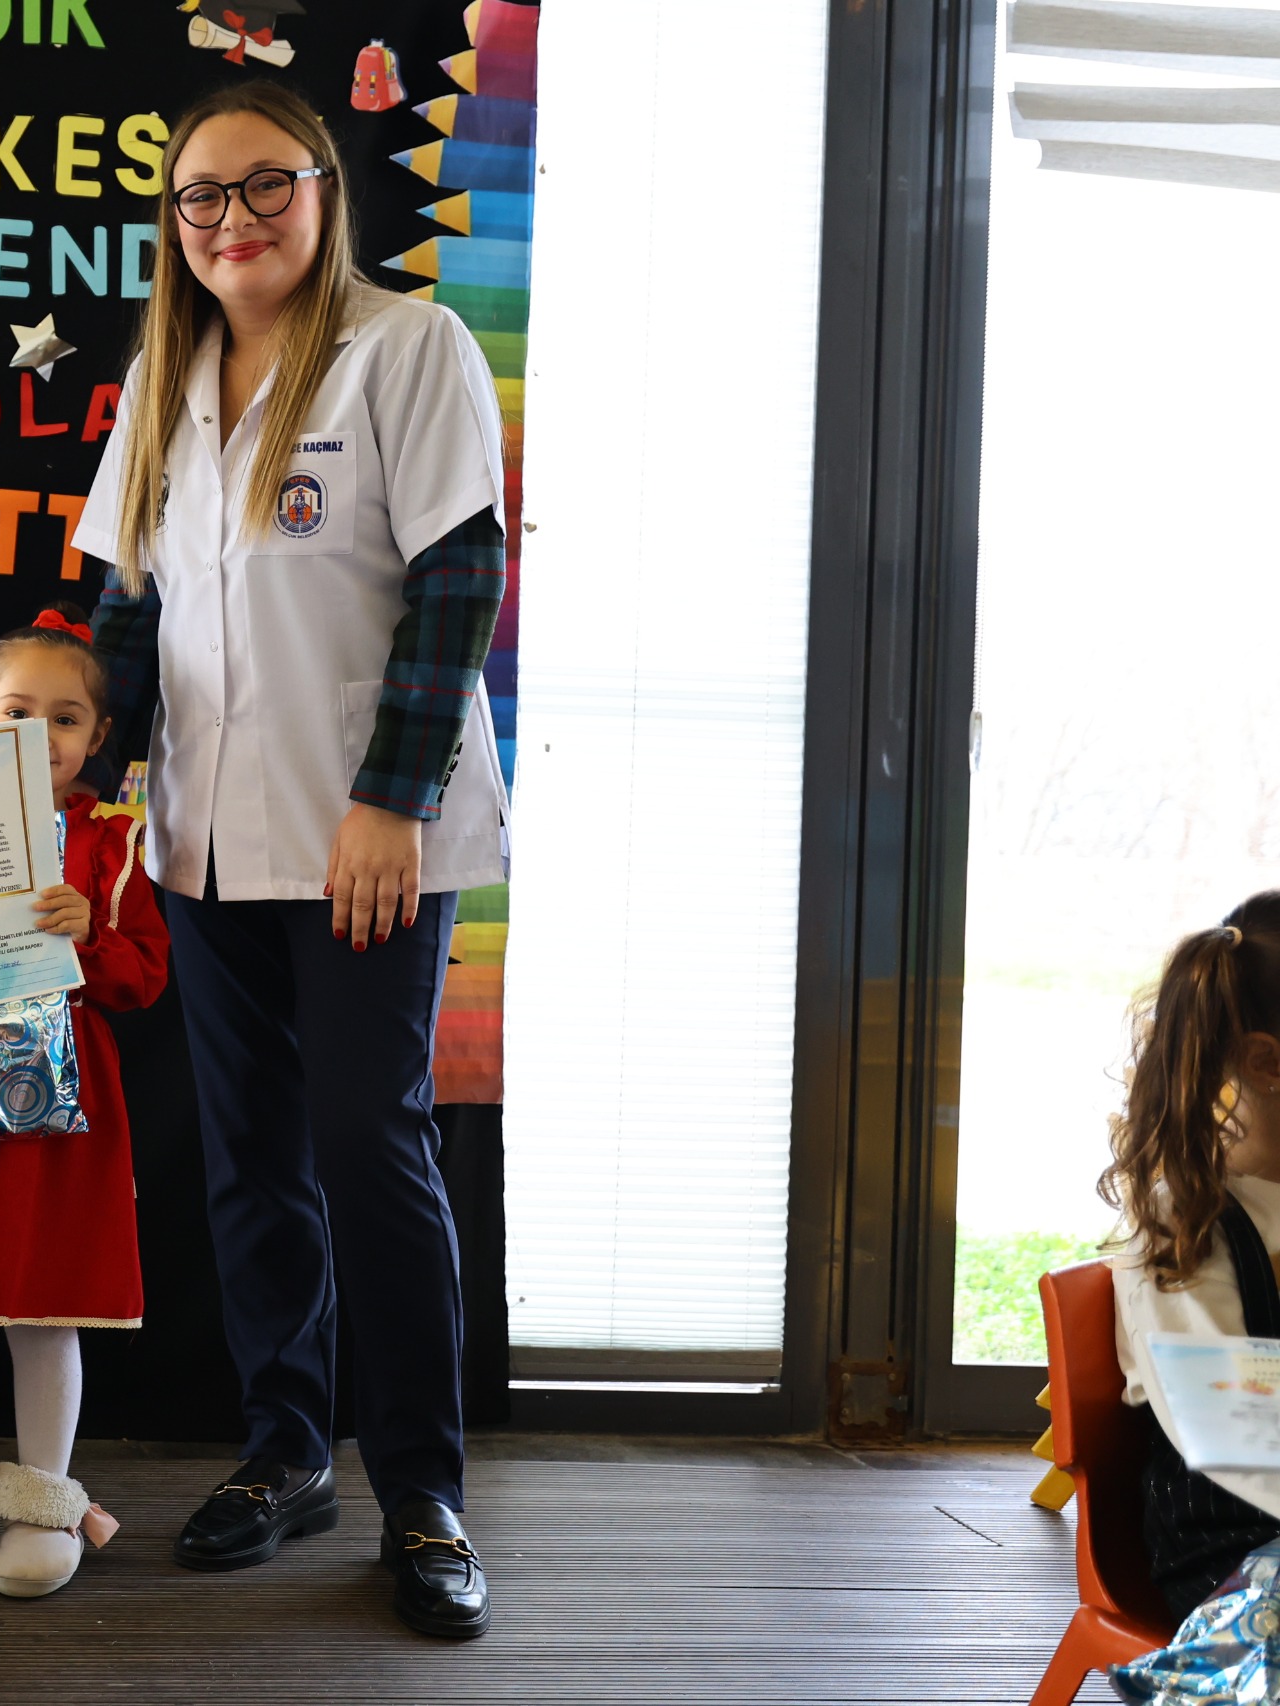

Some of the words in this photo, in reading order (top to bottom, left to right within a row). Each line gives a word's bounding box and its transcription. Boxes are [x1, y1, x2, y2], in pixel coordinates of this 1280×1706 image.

[303, 441, 344, 454] KAÇMAZ
[23, 927, 46, 936] MÜDÜRL
[6, 945, 24, 953] GELİŞİM
